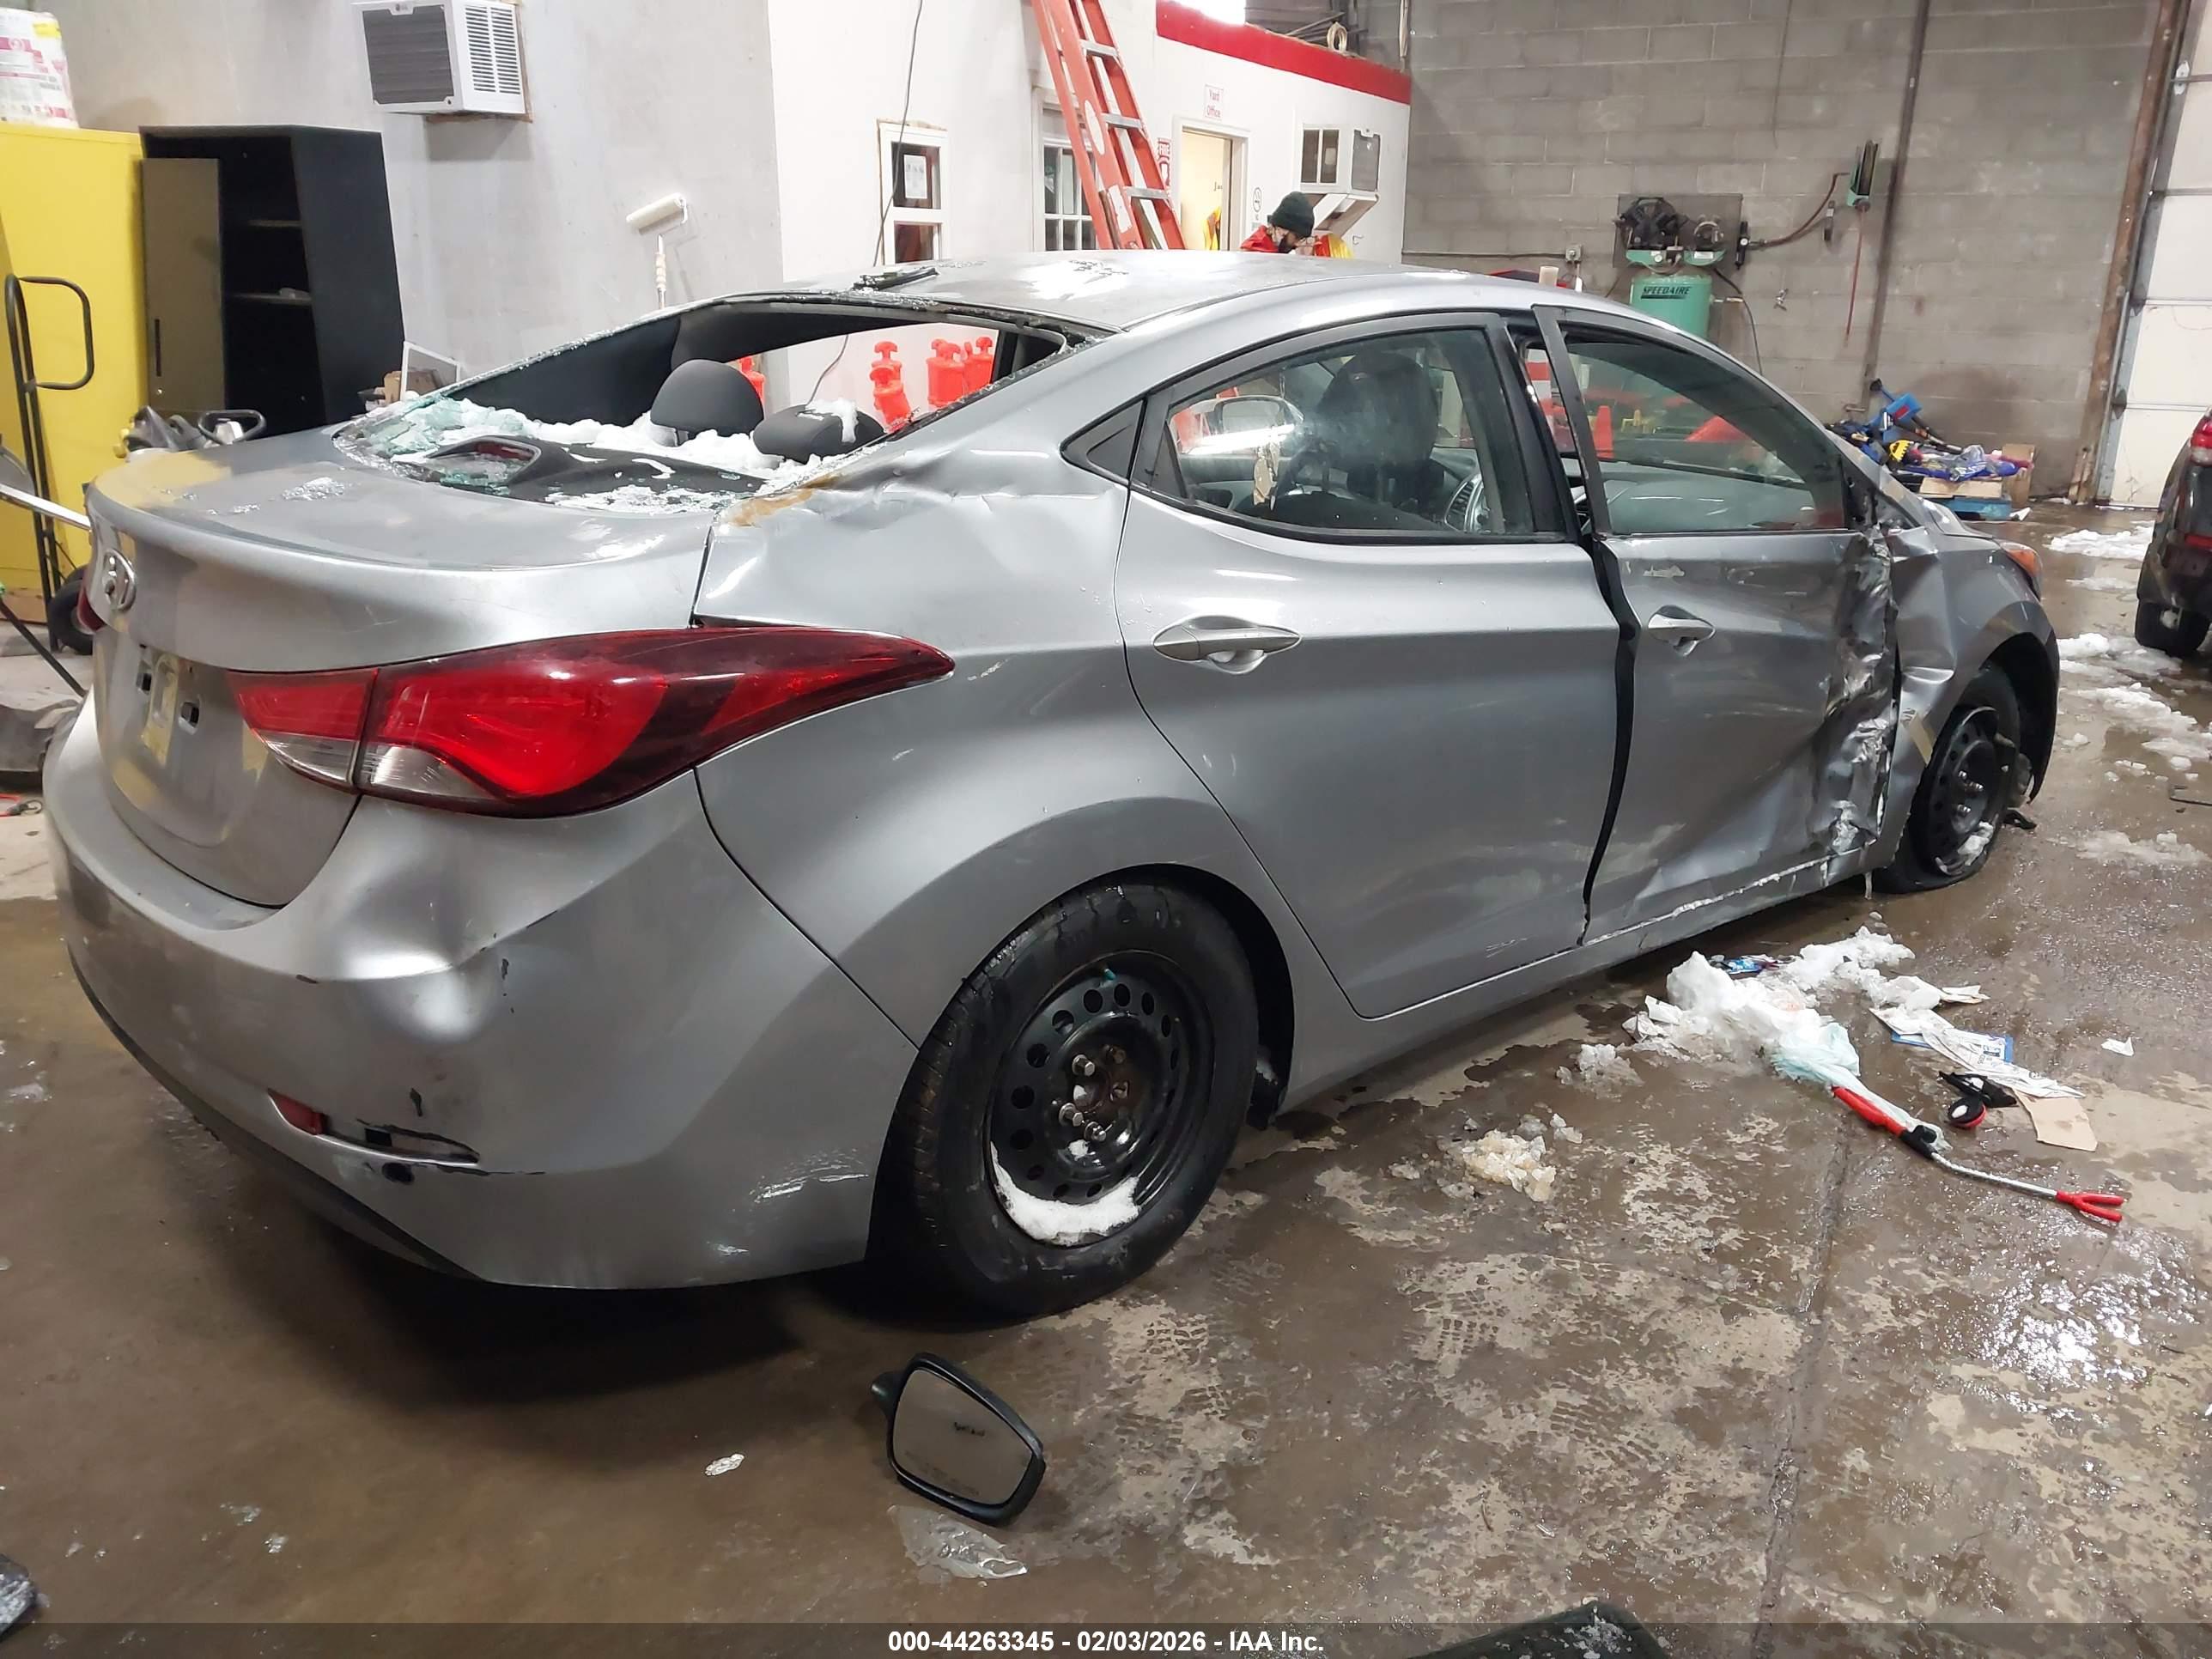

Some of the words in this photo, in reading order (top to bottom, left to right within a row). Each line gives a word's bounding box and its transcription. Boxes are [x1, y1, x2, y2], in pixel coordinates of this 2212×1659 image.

[1209, 88, 1220, 102] Yard
[1206, 105, 1221, 118] Office
[1643, 286, 1692, 295] SPEEDAIRE
